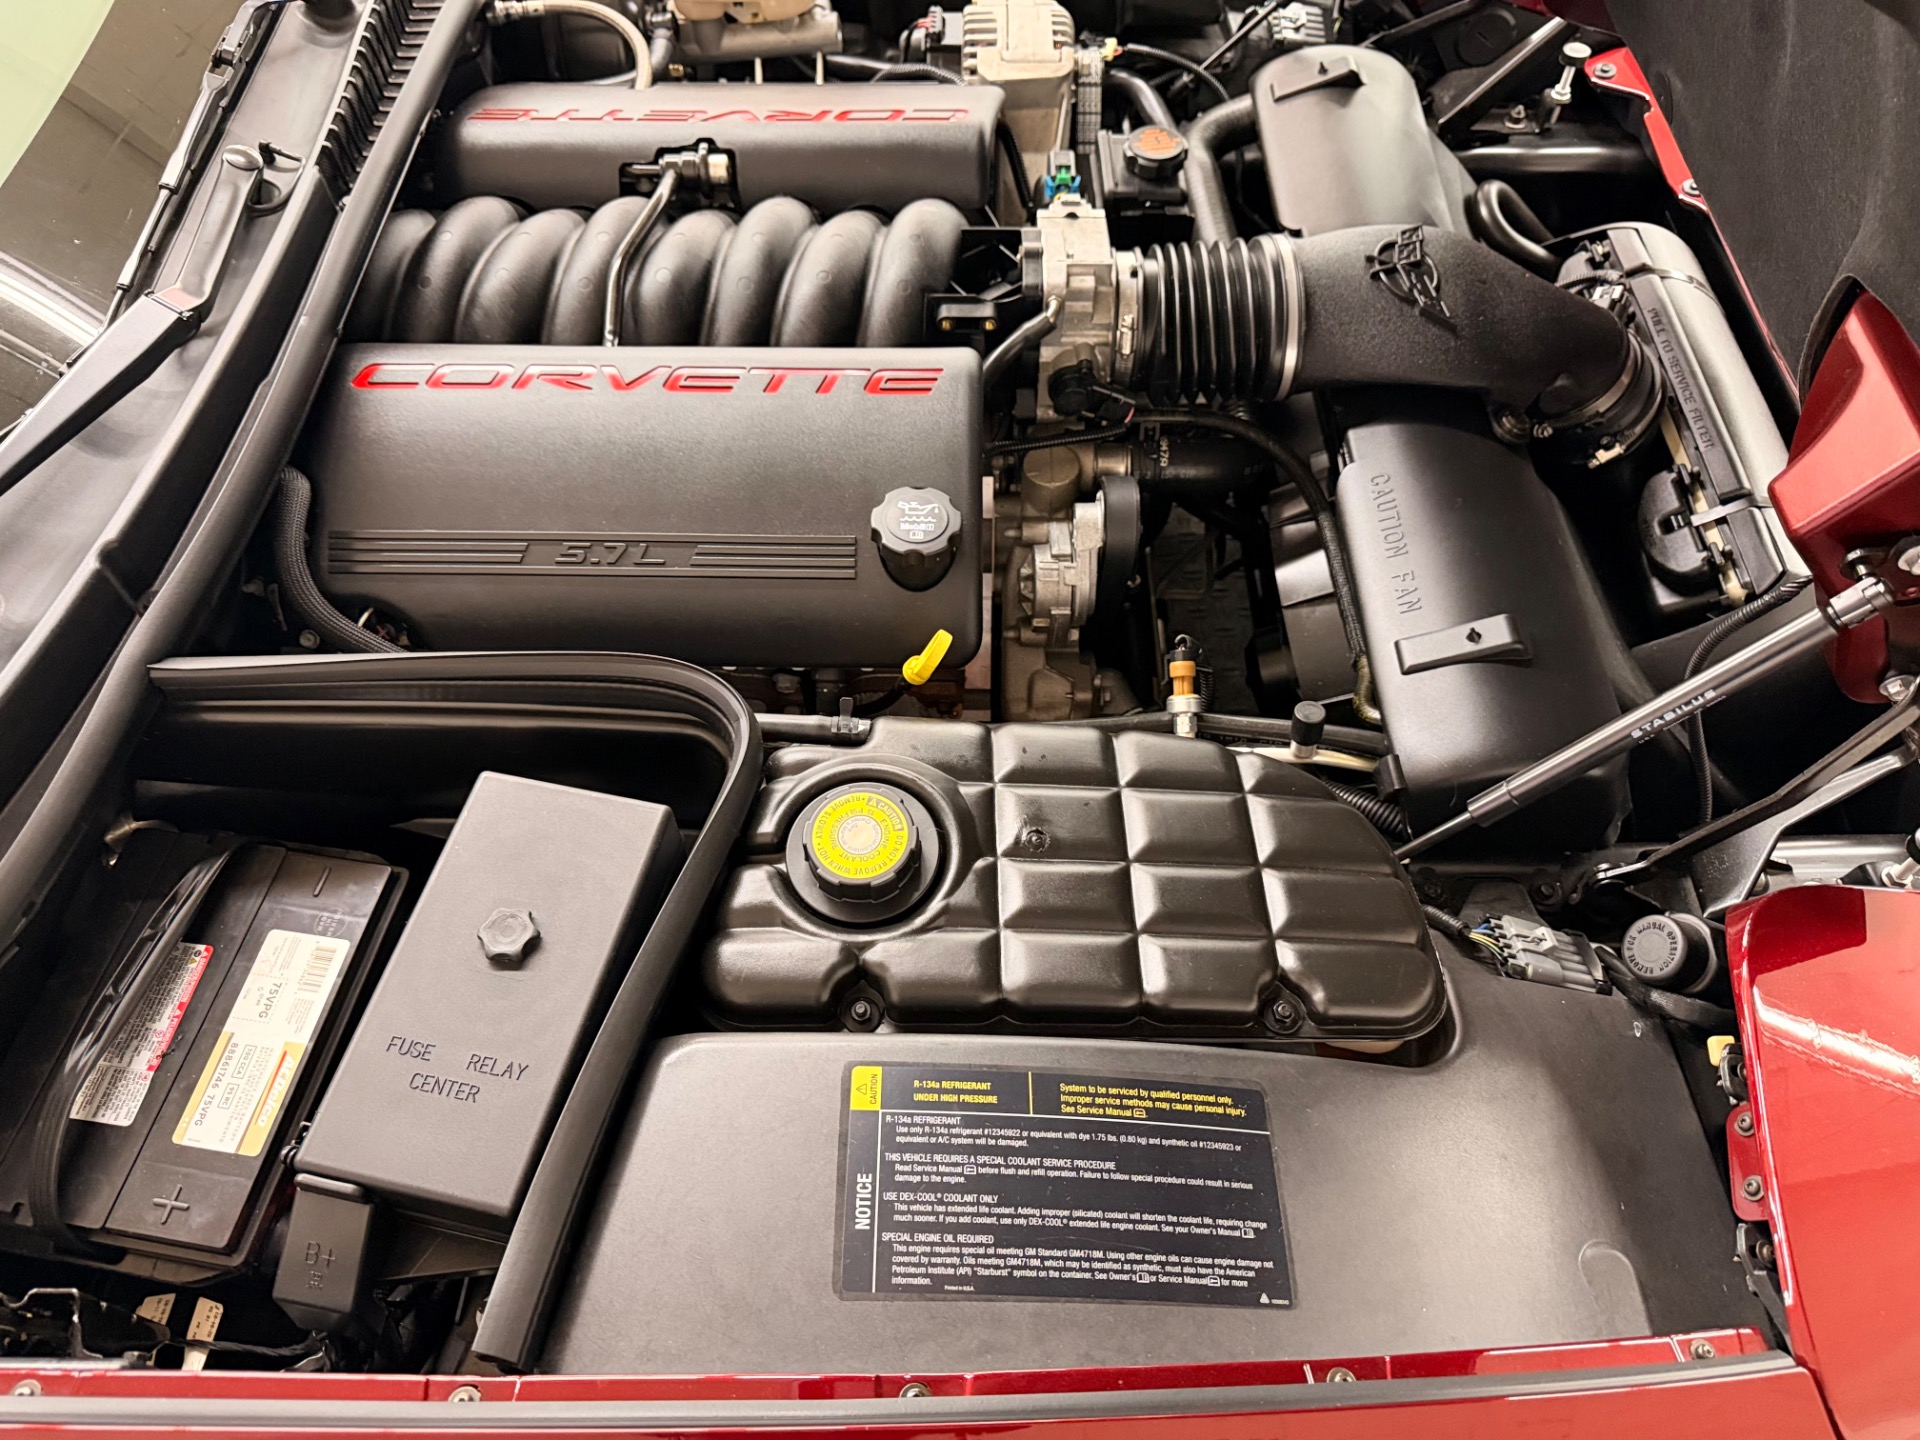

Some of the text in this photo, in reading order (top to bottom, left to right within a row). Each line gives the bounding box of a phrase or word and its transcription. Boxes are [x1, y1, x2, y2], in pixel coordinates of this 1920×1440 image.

[468, 108, 968, 122] CORVETTE
[350, 362, 943, 395] CORVETTE
[1648, 308, 1715, 450] PULL TO SERVICE FILTER
[555, 542, 666, 564] 5.7L
[1370, 474, 1422, 614] CAUTION FAN
[1630, 689, 1716, 739] STABILUS
[832, 795, 861, 811] REMOVE
[878, 802, 902, 830] CAUTION
[815, 811, 831, 839] SLOWLY
[829, 811, 849, 850] PRESSURE
[880, 818, 891, 849] ENGINE
[818, 835, 903, 875] DO NOT REMOVE WHEN HOT
[838, 850, 881, 862] COOLANT
[1626, 921, 1678, 974] REMOVE FOR MANUAL OPERATION
[258, 982, 283, 1019] 75VPG
[234, 1060, 247, 1075] CCA
[386, 1036, 529, 1081] FUSE RELAY
[194, 1042, 238, 1126] 88861746 75VPG
[409, 1072, 480, 1103] CENTER
[870, 1074, 878, 1104] CAUTION
[914, 1080, 991, 1090] R-134a REFRIGERANT
[1059, 1083, 1087, 1093] System
[1108, 1086, 1138, 1095] serviced
[1139, 1088, 1149, 1098] by
[1149, 1089, 1180, 1100] qualified
[1181, 1092, 1216, 1103] personnel
[221, 1096, 230, 1106] RC
[913, 1092, 997, 1103] UNDER HIGH PRESSURE
[1060, 1094, 1093, 1104] Improper
[1094, 1096, 1120, 1105] service
[1122, 1098, 1153, 1107] methods
[1154, 1101, 1170, 1110] may
[1171, 1102, 1193, 1110] cause
[1193, 1103, 1224, 1114] personal
[1061, 1104, 1132, 1116] See Service Manual
[885, 1114, 960, 1124] R-134a REFRIGERANT
[895, 1134, 928, 1143] equivalent
[950, 1136, 973, 1145] system
[909, 1125, 923, 1134] only
[949, 1126, 982, 1136] refrigerant
[1029, 1130, 1062, 1138] equivalent
[1078, 1132, 1090, 1141] dye
[1161, 1138, 1189, 1147] synthetic
[884, 1152, 901, 1160] THIS
[902, 1152, 931, 1161] VEHICLE
[933, 1153, 968, 1163] REQUIRES
[976, 1155, 1006, 1164] SPECIAL
[1007, 1156, 1041, 1165] COOLANT
[1042, 1158, 1072, 1167] SERVICE
[1073, 1159, 1115, 1169] PROCEDURE
[894, 1173, 921, 1182] damage
[912, 1163, 937, 1172] Service
[1079, 1170, 1101, 1178] Failure
[1110, 1172, 1130, 1180] follow
[1130, 1173, 1153, 1182] special
[1153, 1175, 1186, 1184] procedure
[1186, 1177, 1204, 1185] could
[1204, 1178, 1222, 1187] result
[1230, 1181, 1253, 1189] serious
[855, 1173, 872, 1230] NOTICE
[882, 1191, 898, 1200] USE
[943, 1193, 977, 1202] COOLANT
[979, 1194, 998, 1203] ONLY
[947, 1204, 977, 1212] extended
[1016, 1206, 1040, 1216] Adding
[1041, 1208, 1070, 1217] improper
[1104, 1211, 1128, 1219] coolant
[1141, 1213, 1166, 1221] shorten
[1178, 1215, 1202, 1223] coolant
[1215, 1218, 1244, 1228] requiring
[1244, 1220, 1267, 1230] change
[881, 1232, 994, 1243] SPECIAL ENGINE OIL REQUIRED
[305, 1240, 336, 1267] B+
